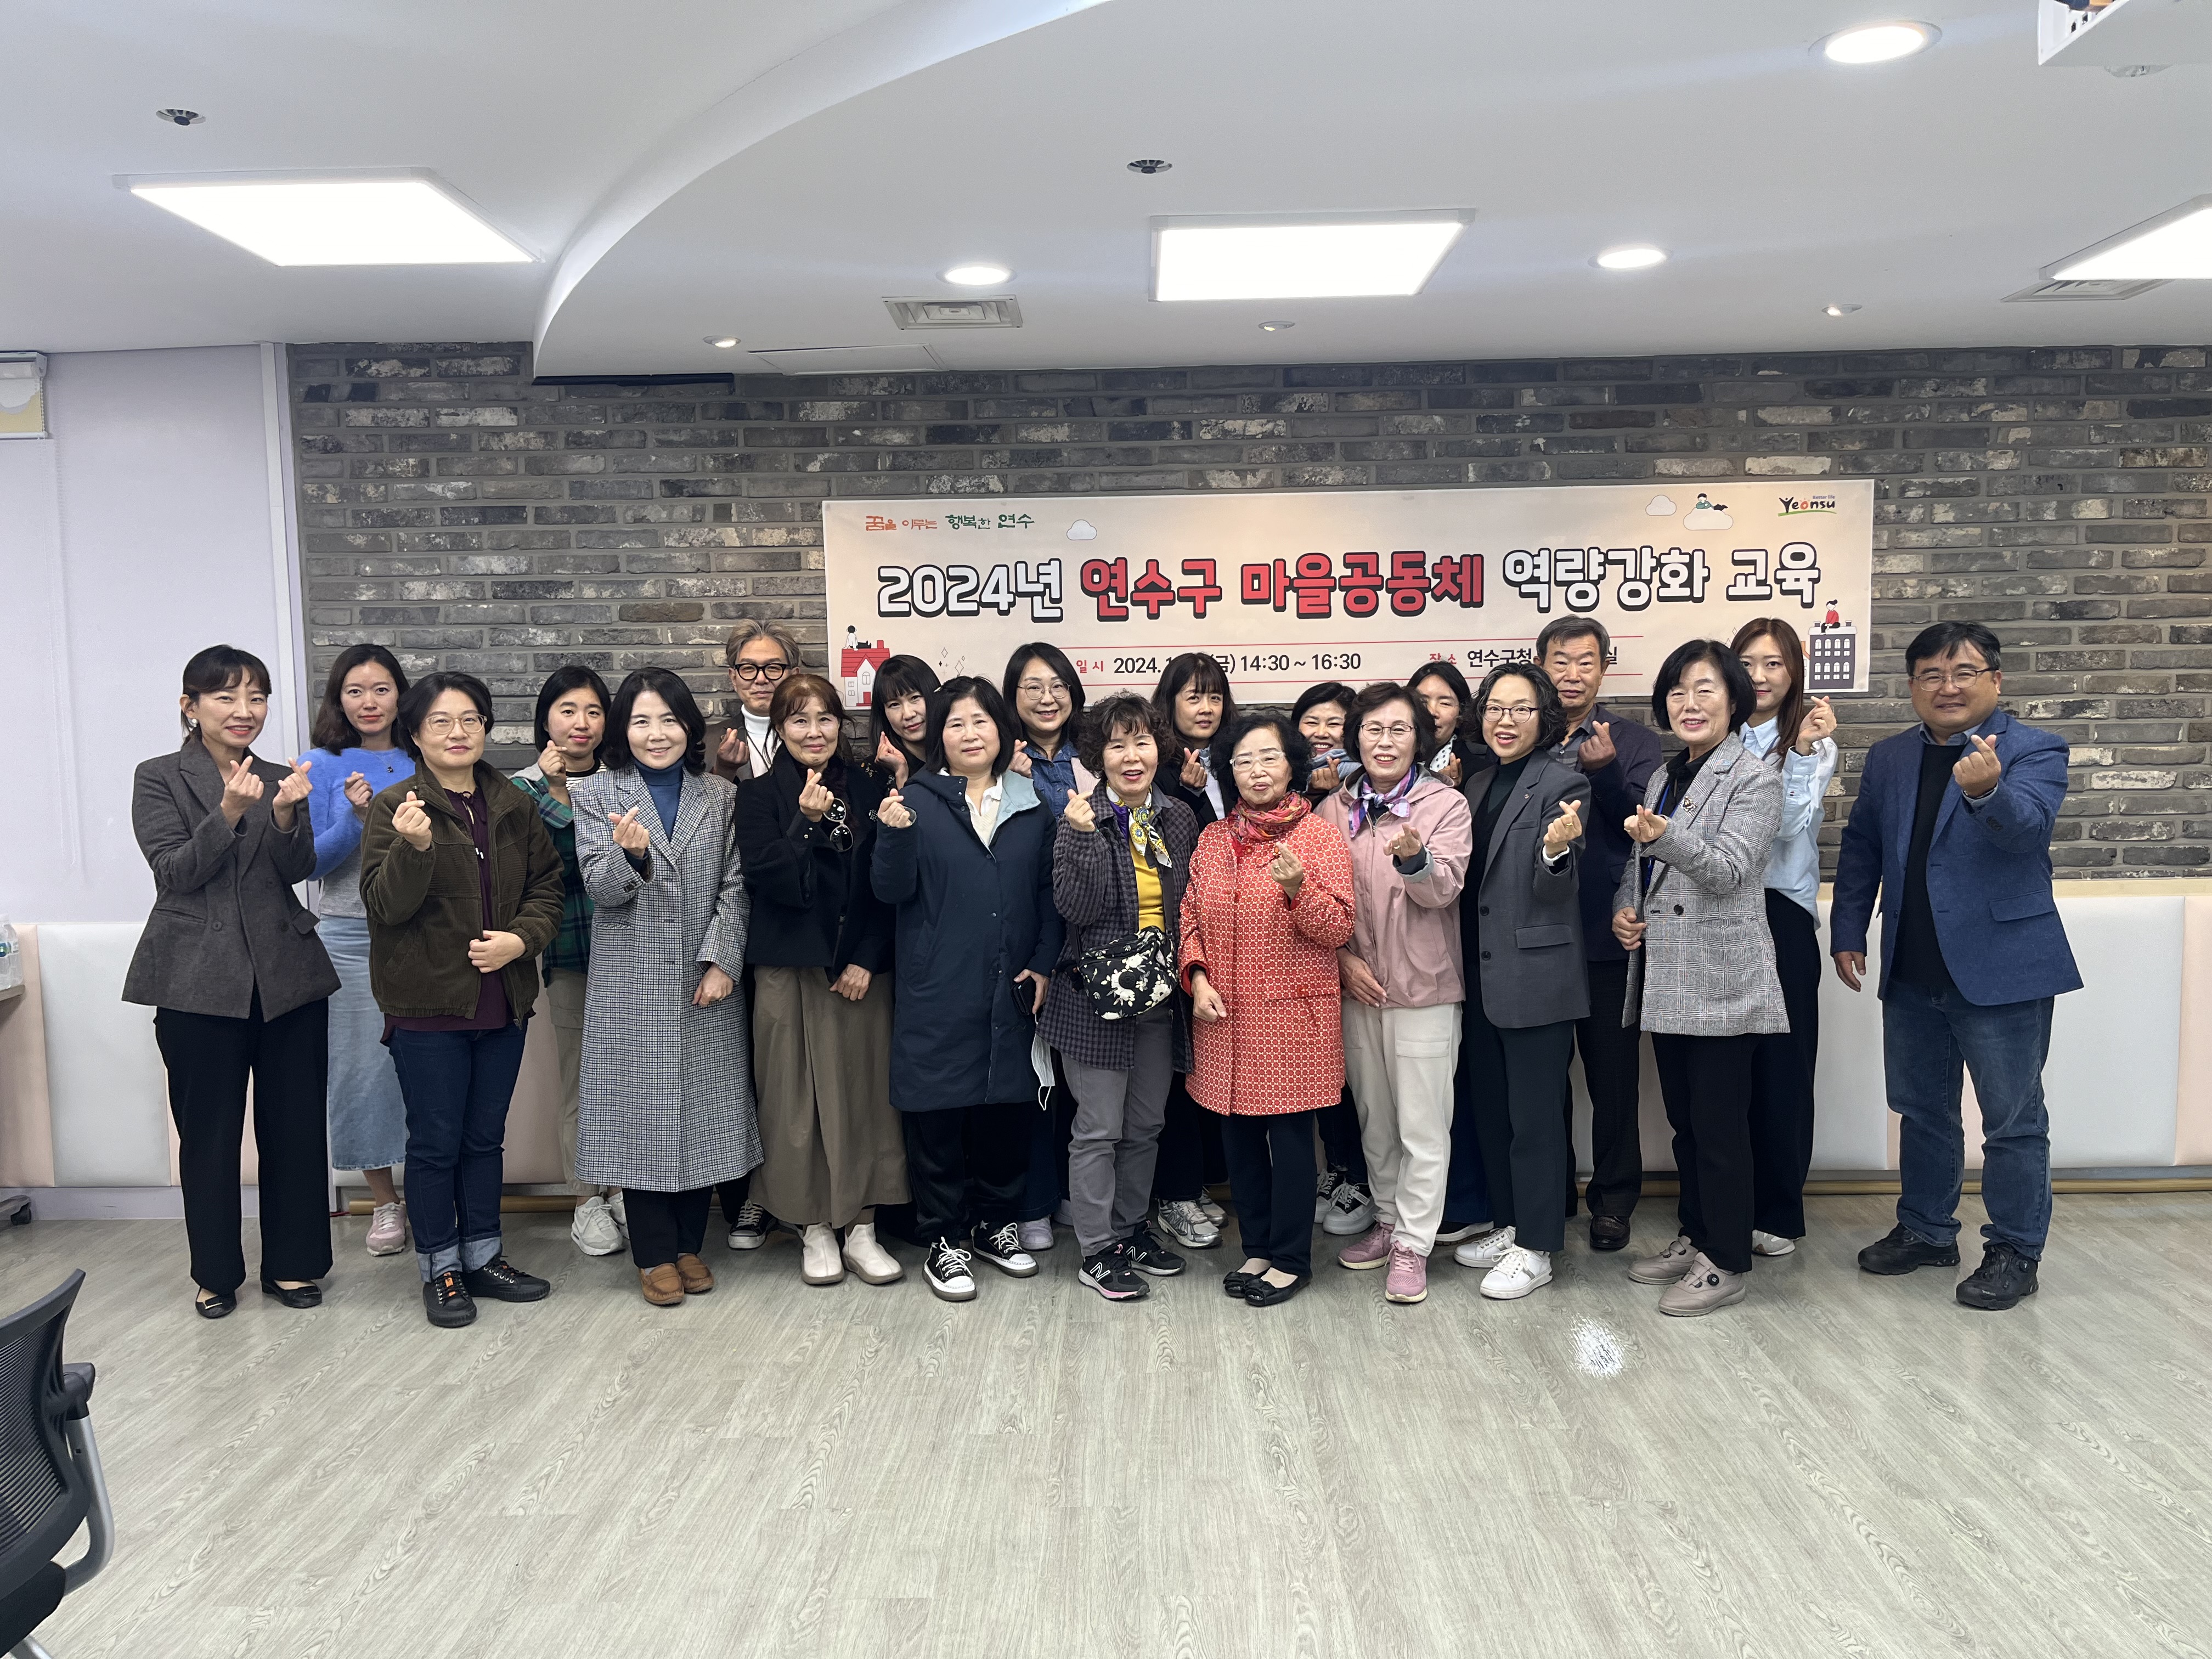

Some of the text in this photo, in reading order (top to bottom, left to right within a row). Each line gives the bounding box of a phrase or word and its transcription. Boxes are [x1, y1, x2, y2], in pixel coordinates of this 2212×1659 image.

[1779, 496, 1835, 514] Yeonsu
[866, 514, 1035, 531] 꿈을 이루는 행복한 연수
[878, 542, 1821, 623] 2024년 연수구 마을공동체 역량강화 교육
[1241, 655, 1289, 671] 14:30
[1312, 653, 1361, 670] 16:30
[1468, 648, 1531, 668] 연수구청
